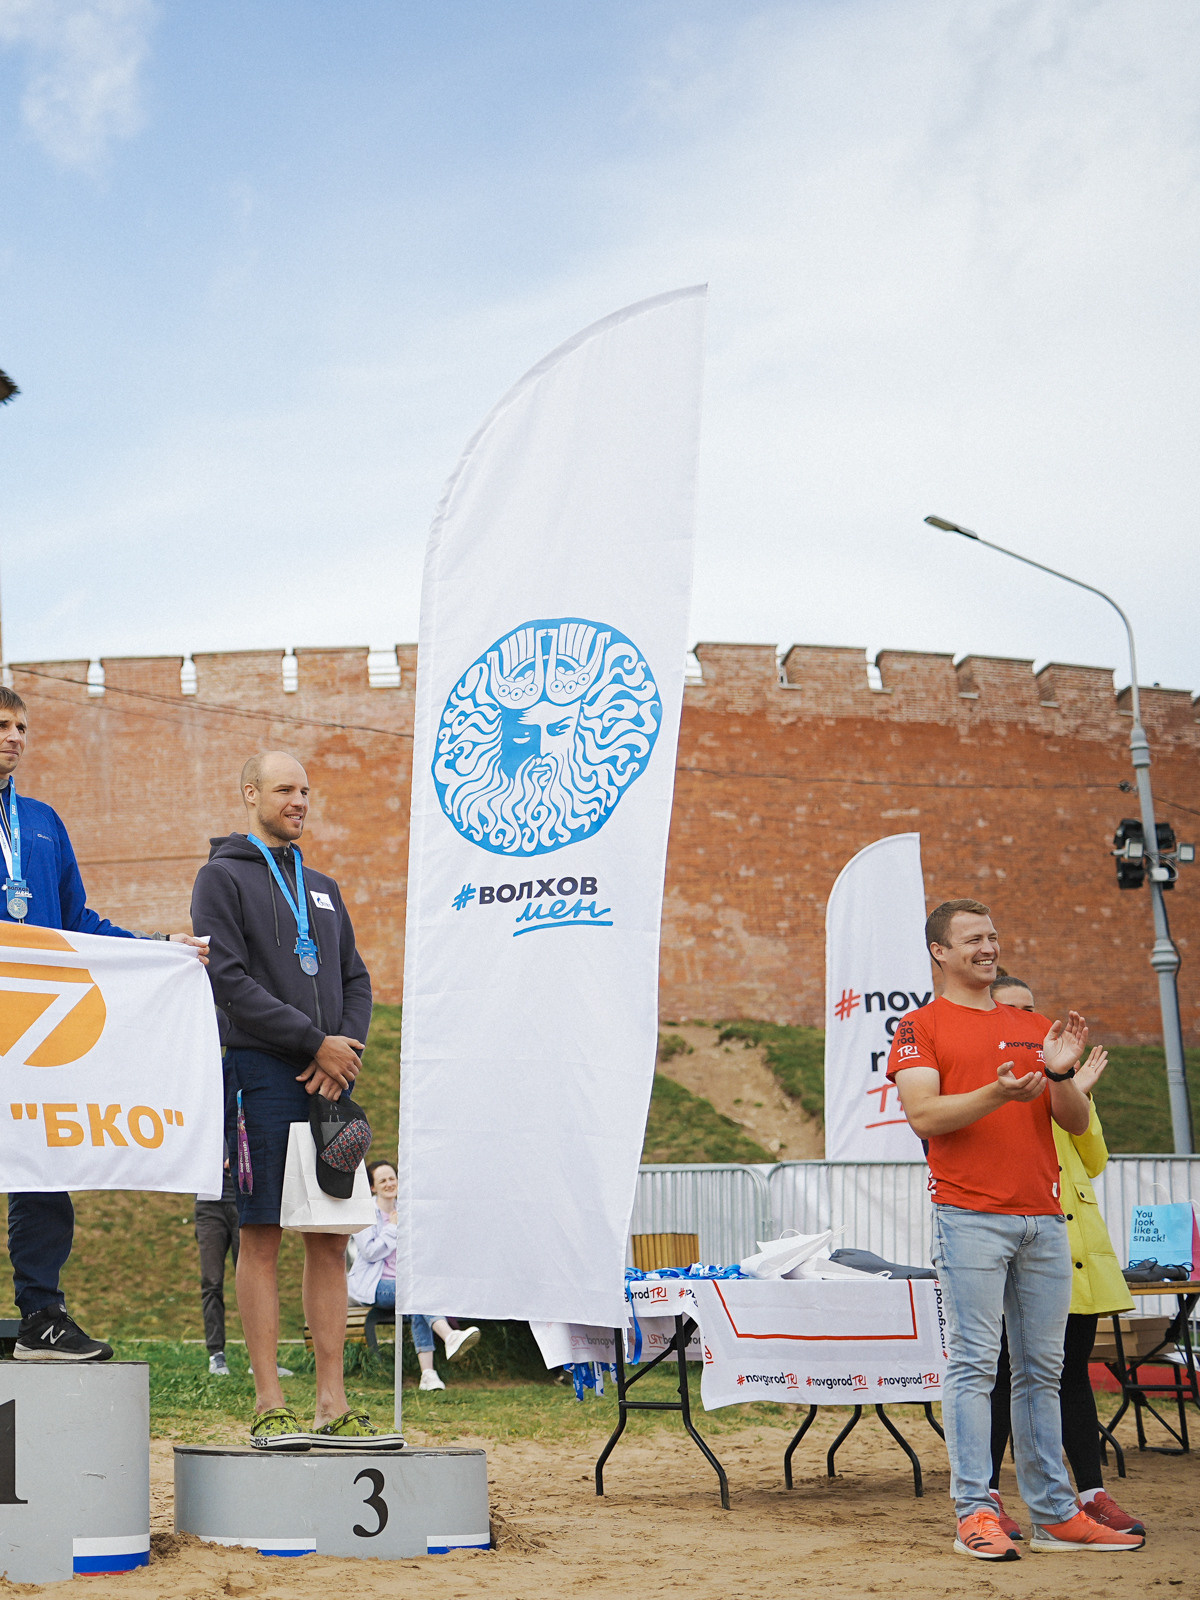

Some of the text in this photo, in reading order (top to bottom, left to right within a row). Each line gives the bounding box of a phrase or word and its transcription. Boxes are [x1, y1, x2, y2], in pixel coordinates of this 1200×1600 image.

[451, 876, 598, 911] #ВОЛХОВ
[515, 898, 611, 923] мен
[834, 988, 932, 1021] #nov
[900, 1027, 914, 1037] go
[897, 1034, 916, 1046] rod
[998, 1040, 1044, 1050] #novgoro
[10, 1103, 184, 1150] "БКО"
[1136, 1210, 1153, 1219] You
[1135, 1218, 1155, 1226] look
[1134, 1226, 1151, 1234] like
[1133, 1234, 1165, 1242] snack!
[353, 1468, 388, 1537] 3
